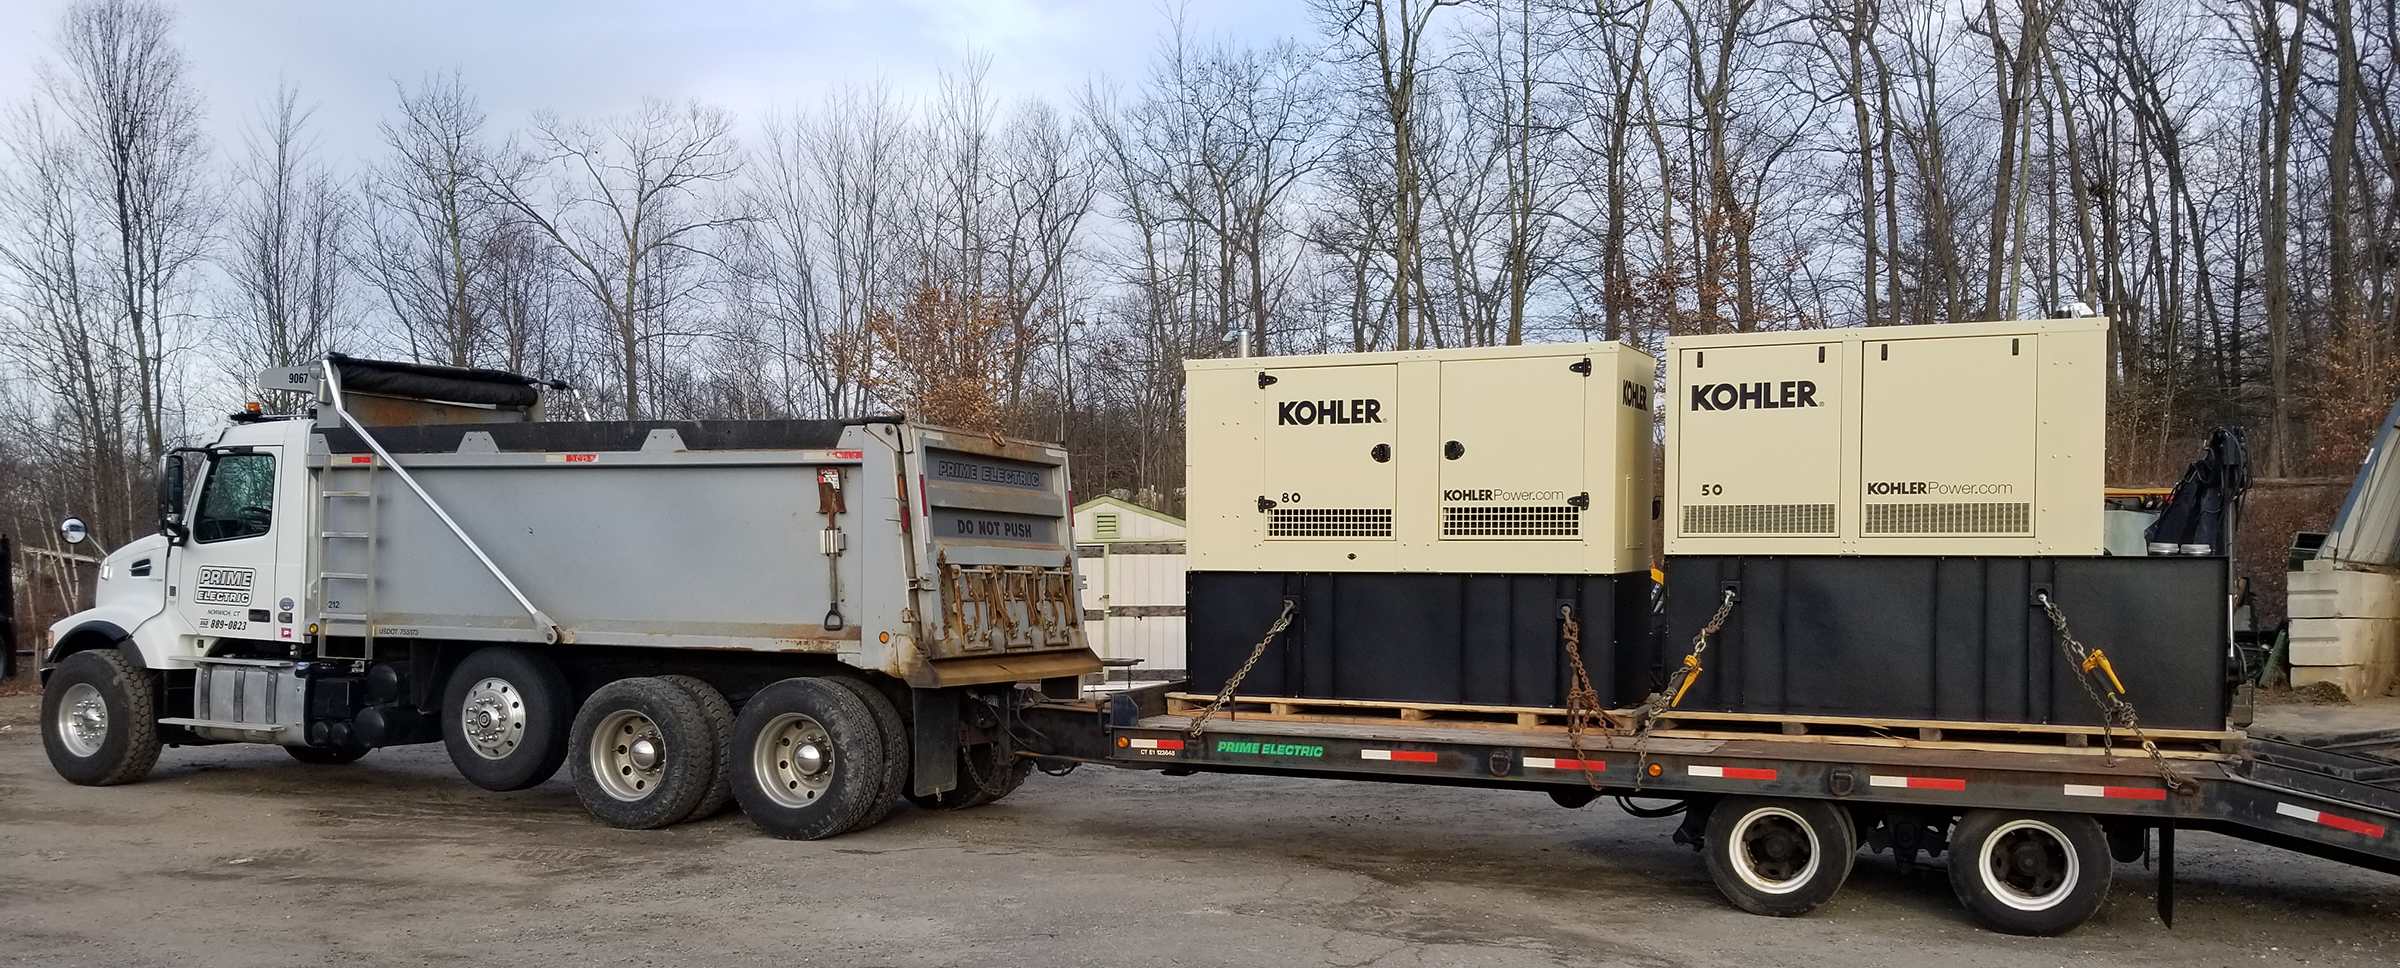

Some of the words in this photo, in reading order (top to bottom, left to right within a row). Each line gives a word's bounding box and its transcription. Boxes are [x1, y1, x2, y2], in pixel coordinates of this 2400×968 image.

[289, 373, 308, 383] 9067
[1623, 379, 1647, 411] KOHLER
[1691, 380, 1818, 411] KOHLER
[1279, 399, 1382, 425] KOHLER
[939, 461, 977, 480] PRIME
[982, 466, 1040, 486] ELECTRIC
[1444, 489, 1564, 501] KOHLERPower.com
[1701, 484, 1723, 496] 50
[1867, 481, 2013, 495] KOHLERPower.com
[1282, 493, 1301, 503] 80
[957, 520, 974, 534] DO
[979, 521, 1000, 536] NOT
[1004, 523, 1032, 538] PUSH
[200, 569, 252, 587] PRIME
[197, 590, 249, 603] ELECTRIC
[210, 619, 247, 631] 889-0823
[1217, 741, 1259, 754] PRIME
[1261, 743, 1324, 757] ELECTRIC
